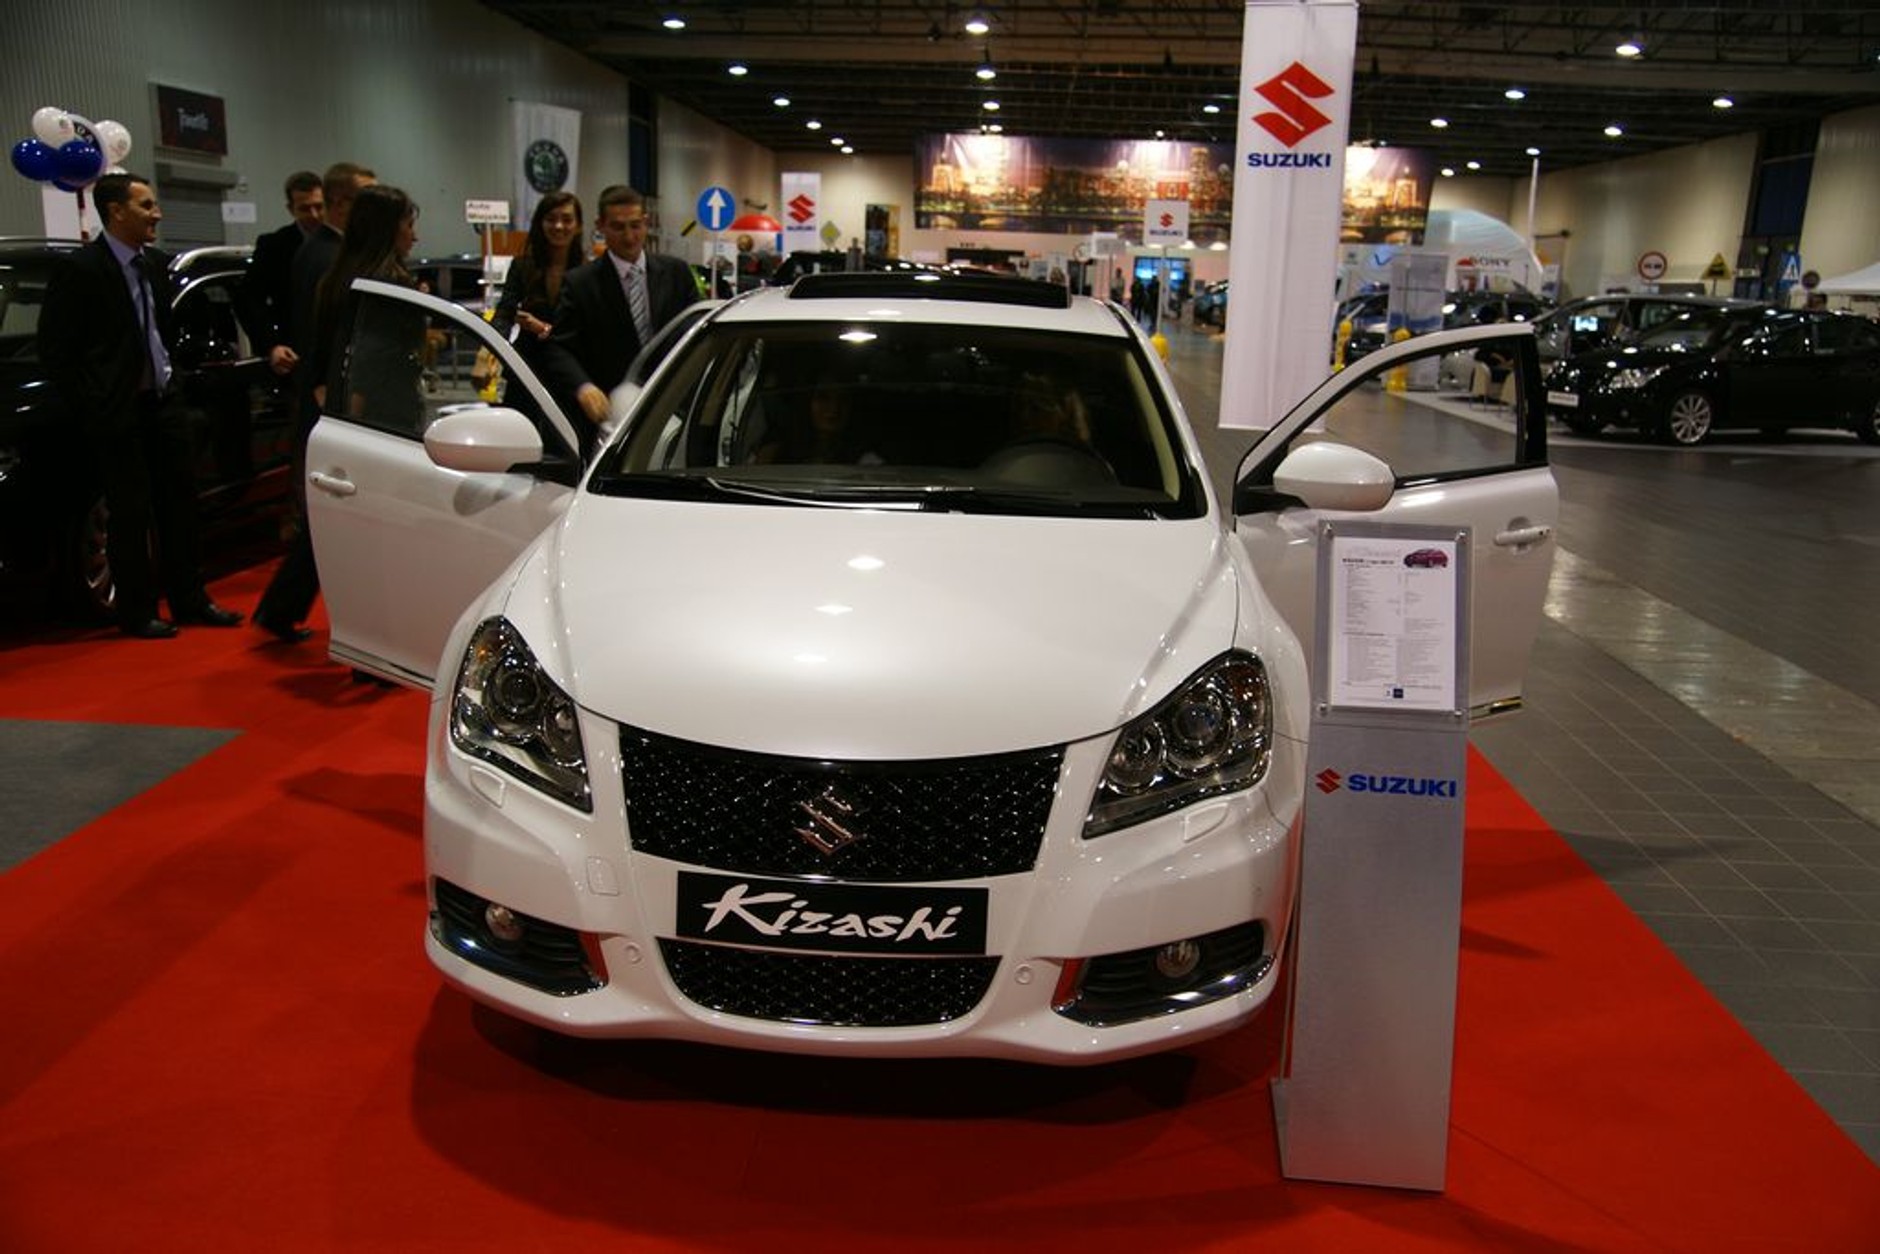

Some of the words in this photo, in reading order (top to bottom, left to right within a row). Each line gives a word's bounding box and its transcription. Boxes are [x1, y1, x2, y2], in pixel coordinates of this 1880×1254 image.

[1247, 152, 1332, 168] SUZUKI
[1347, 773, 1457, 798] SUZUKI
[701, 883, 963, 942] Kizashi
